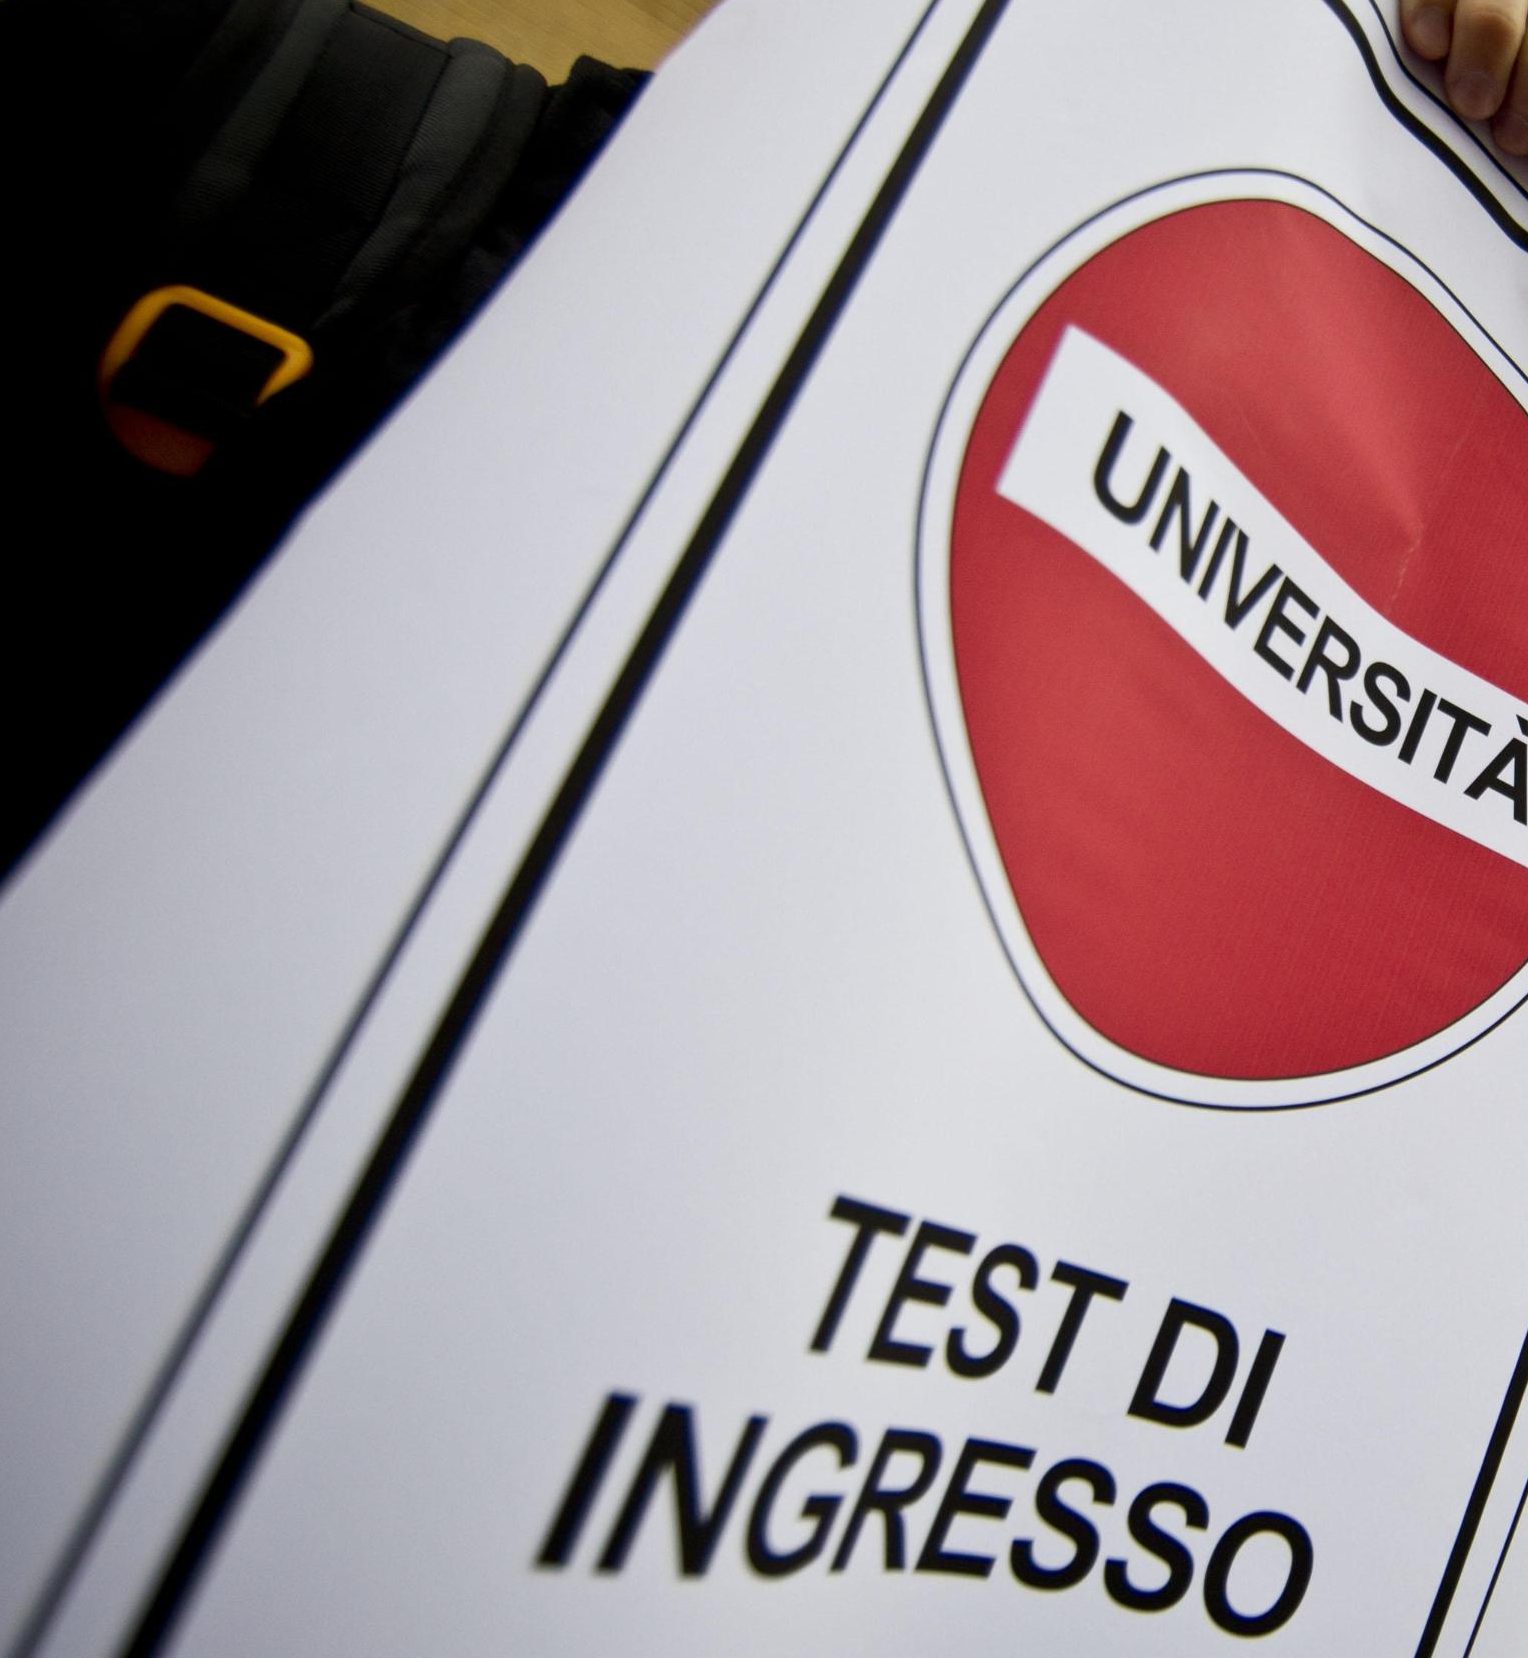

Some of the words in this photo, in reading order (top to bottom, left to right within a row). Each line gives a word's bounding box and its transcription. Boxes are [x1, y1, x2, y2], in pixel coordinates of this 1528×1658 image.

[810, 1195, 1129, 1395] TEST
[1127, 1297, 1287, 1450] DI
[535, 1390, 1315, 1639] INGRESSO
